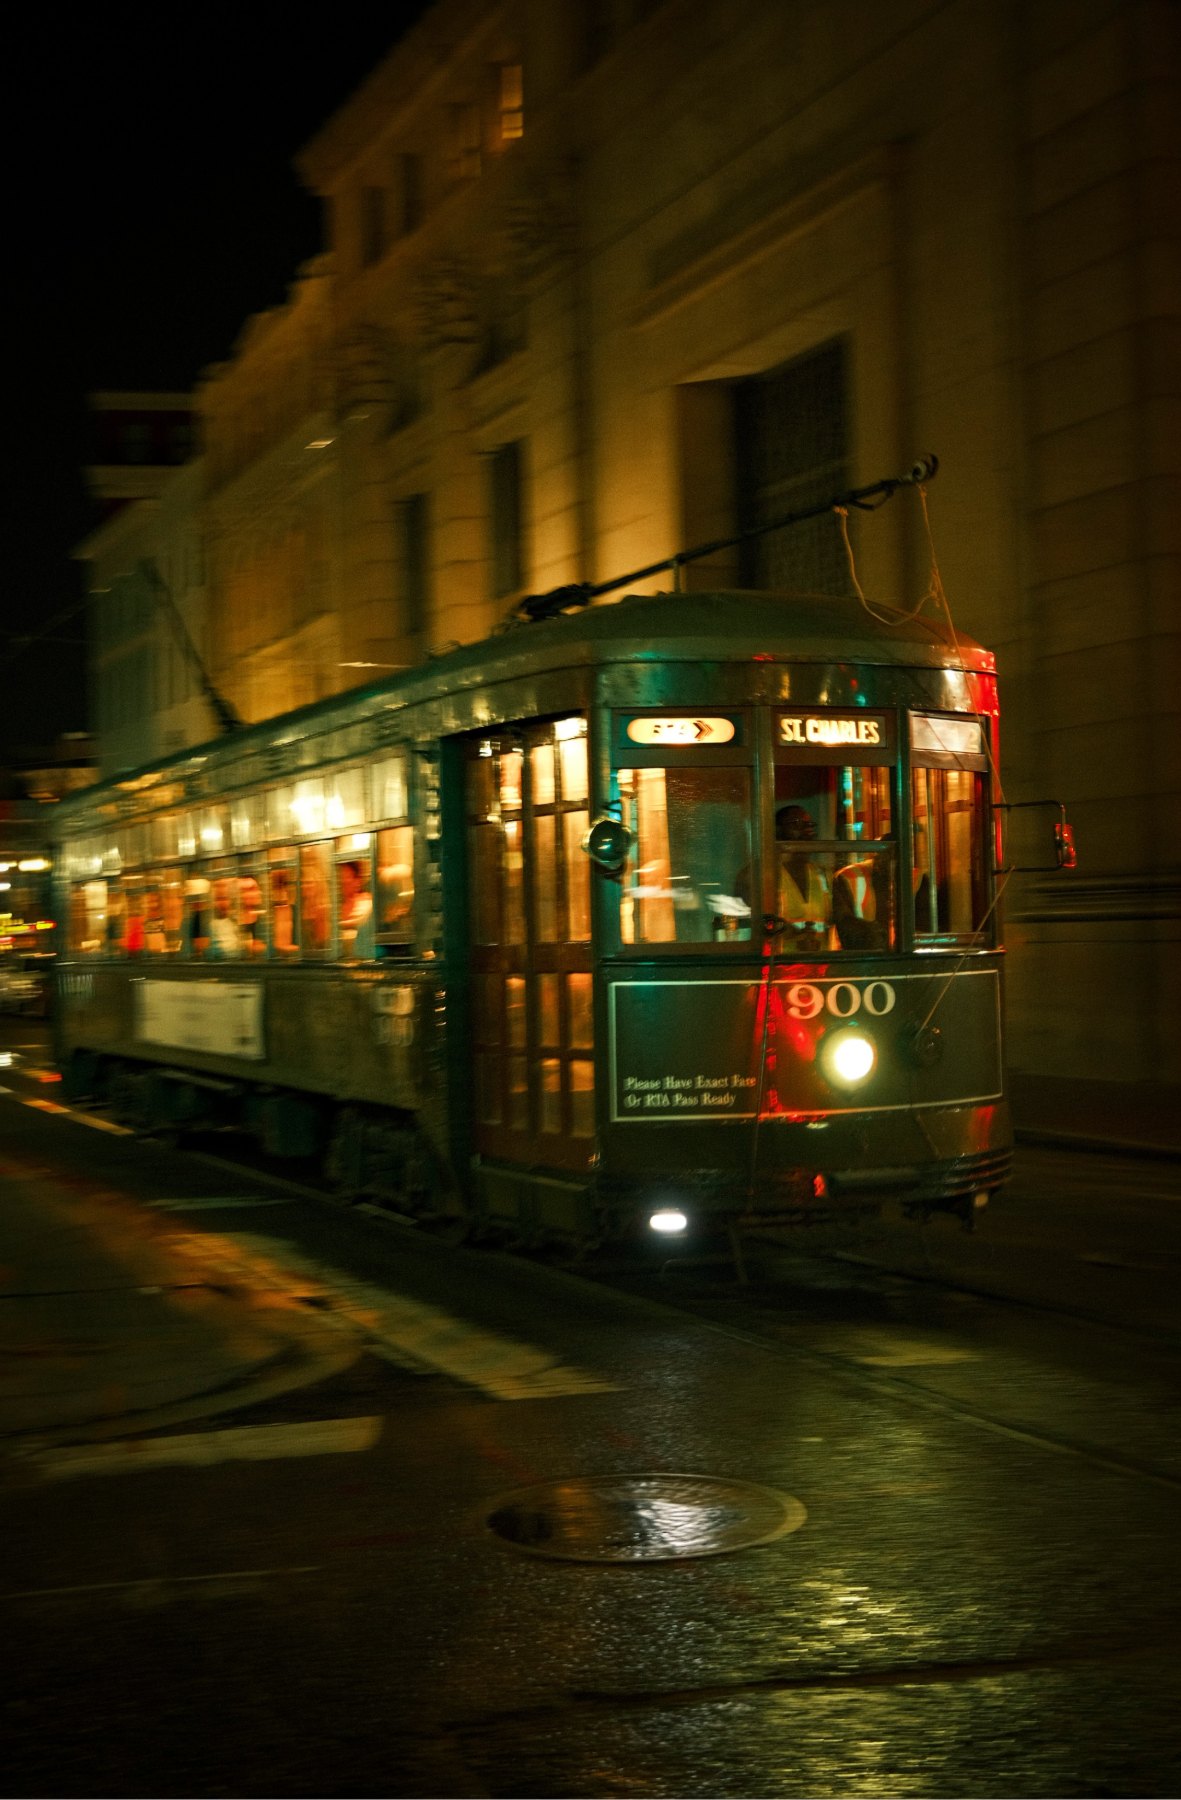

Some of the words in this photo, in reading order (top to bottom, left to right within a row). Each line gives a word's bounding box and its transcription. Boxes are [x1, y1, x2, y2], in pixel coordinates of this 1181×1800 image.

[806, 719, 880, 744] CHARLES
[787, 981, 896, 1019] 900
[624, 1076, 661, 1090] Please
[663, 1075, 693, 1089] Have
[695, 1074, 729, 1089] Exact
[731, 1074, 757, 1088] Fare
[624, 1093, 642, 1108] Or
[643, 1093, 671, 1108] RTA
[672, 1092, 699, 1106] Pass
[700, 1091, 736, 1106] Ready
